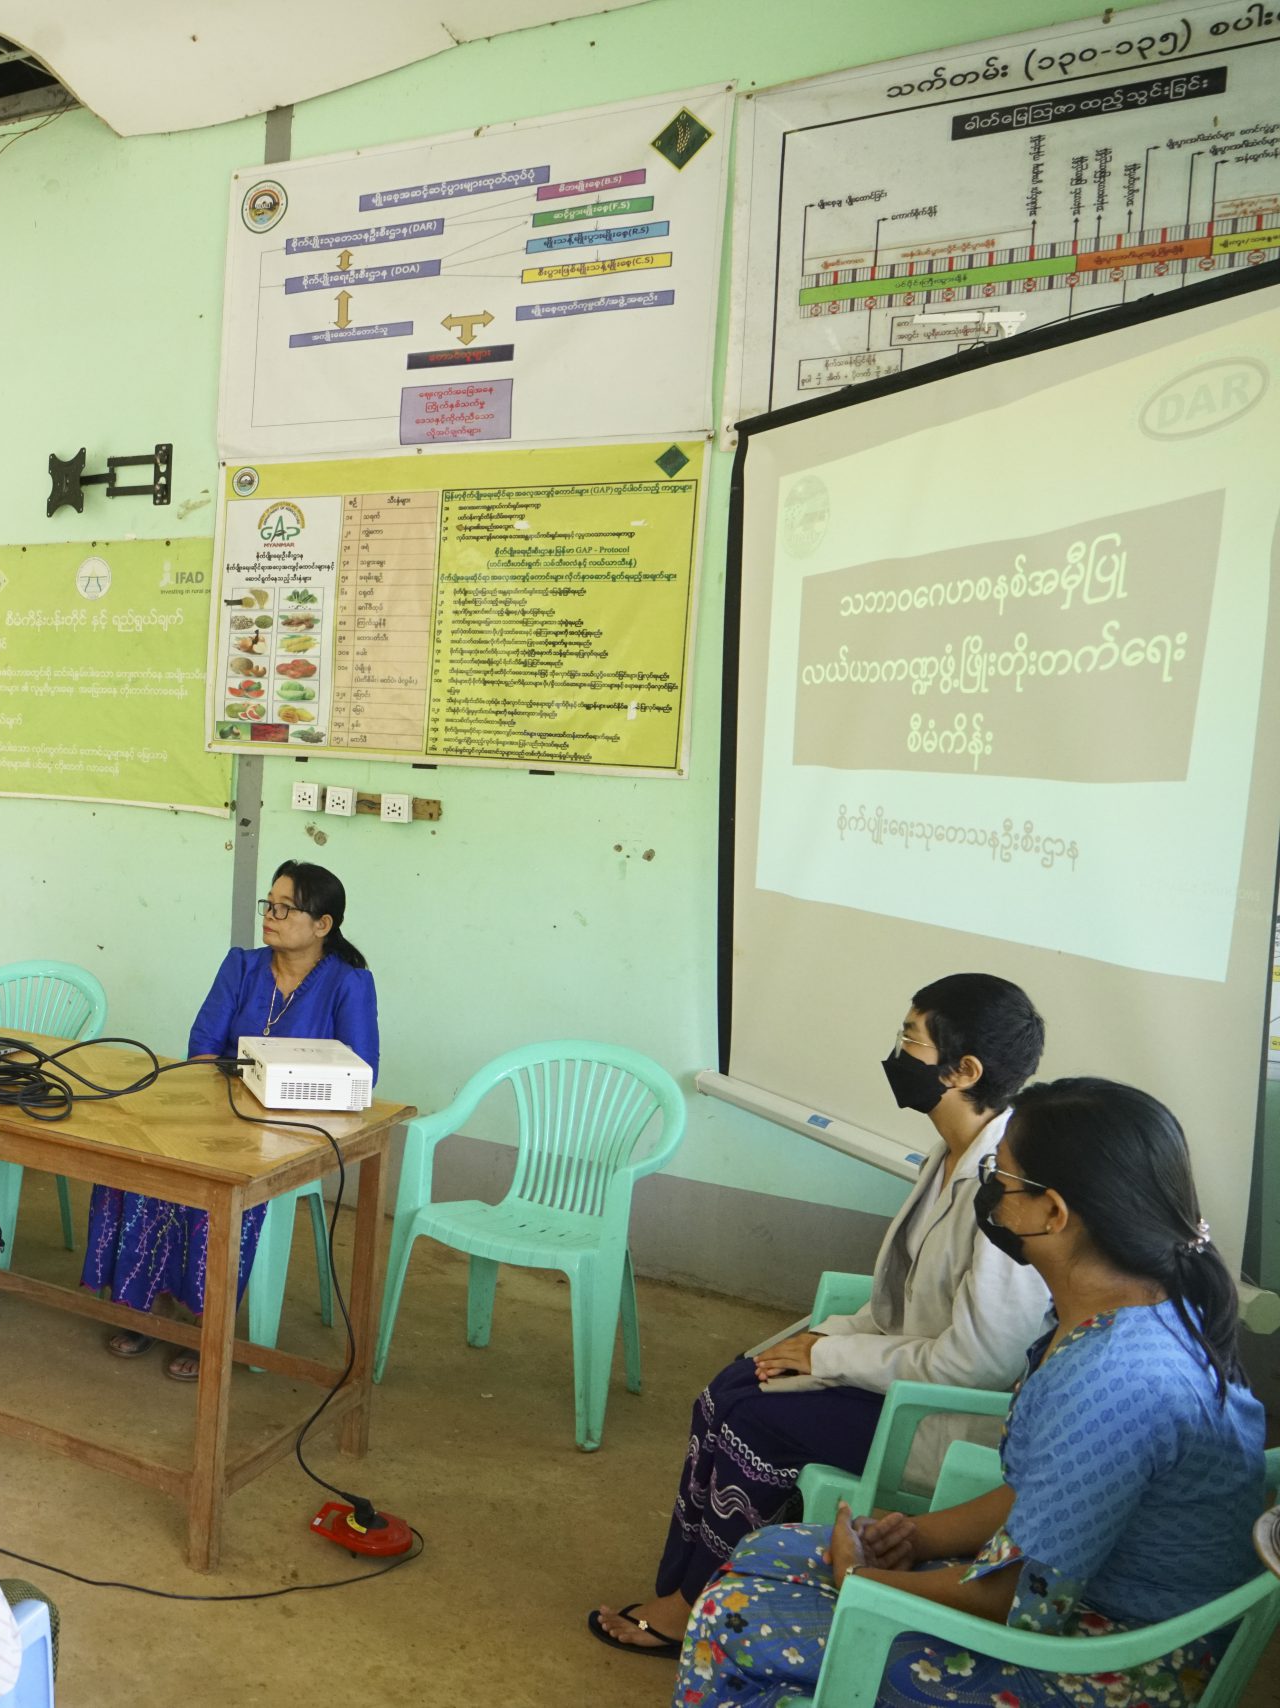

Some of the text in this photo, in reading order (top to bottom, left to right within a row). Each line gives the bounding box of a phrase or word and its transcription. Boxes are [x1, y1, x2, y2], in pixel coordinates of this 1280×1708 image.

[885, 3, 1280, 100] သက်တမ်း (၁၃၀-၁၃၅) စပါး
[391, 263, 420, 276] (DOA)
[1157, 371, 1250, 429] DAR
[260, 515, 301, 542] GAP
[160, 588, 184, 596] Investing
[175, 571, 205, 585] IFAD
[839, 532, 1128, 617] သဘာဝဂေဟစနစ်အမှီပြု
[801, 619, 1188, 696] လယ်ယာကဏ္ဍဖွံ့ဖြိုးတိုးတက်ရေး
[907, 712, 994, 771] စီမံကိန်း
[835, 804, 1080, 869] စိုက်ပျိုးရေးသုတေသနဦးစီးဌာန
